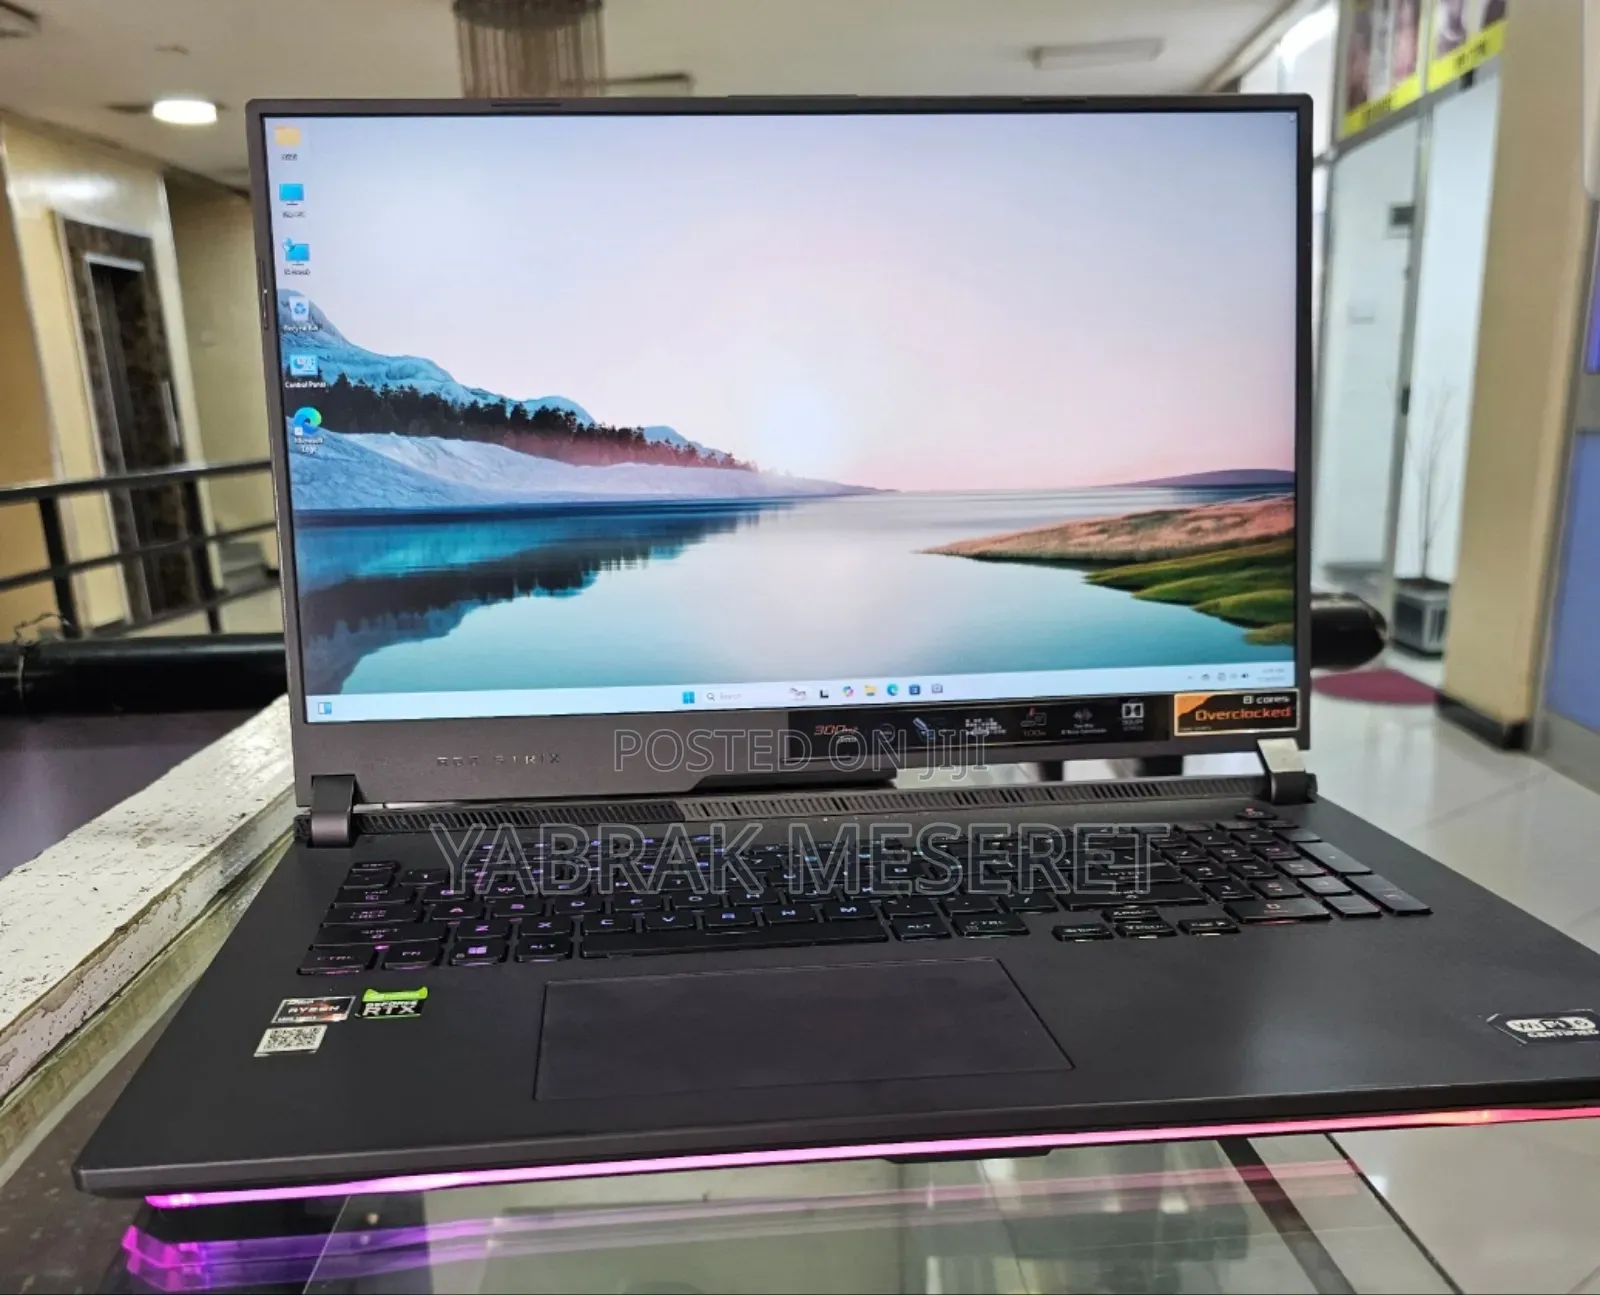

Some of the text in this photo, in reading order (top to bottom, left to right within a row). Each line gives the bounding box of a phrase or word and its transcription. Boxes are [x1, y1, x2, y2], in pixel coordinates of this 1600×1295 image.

[1256, 696, 1290, 704] cores
[1195, 706, 1292, 721] Overclocked
[362, 1005, 417, 1017] RTX
